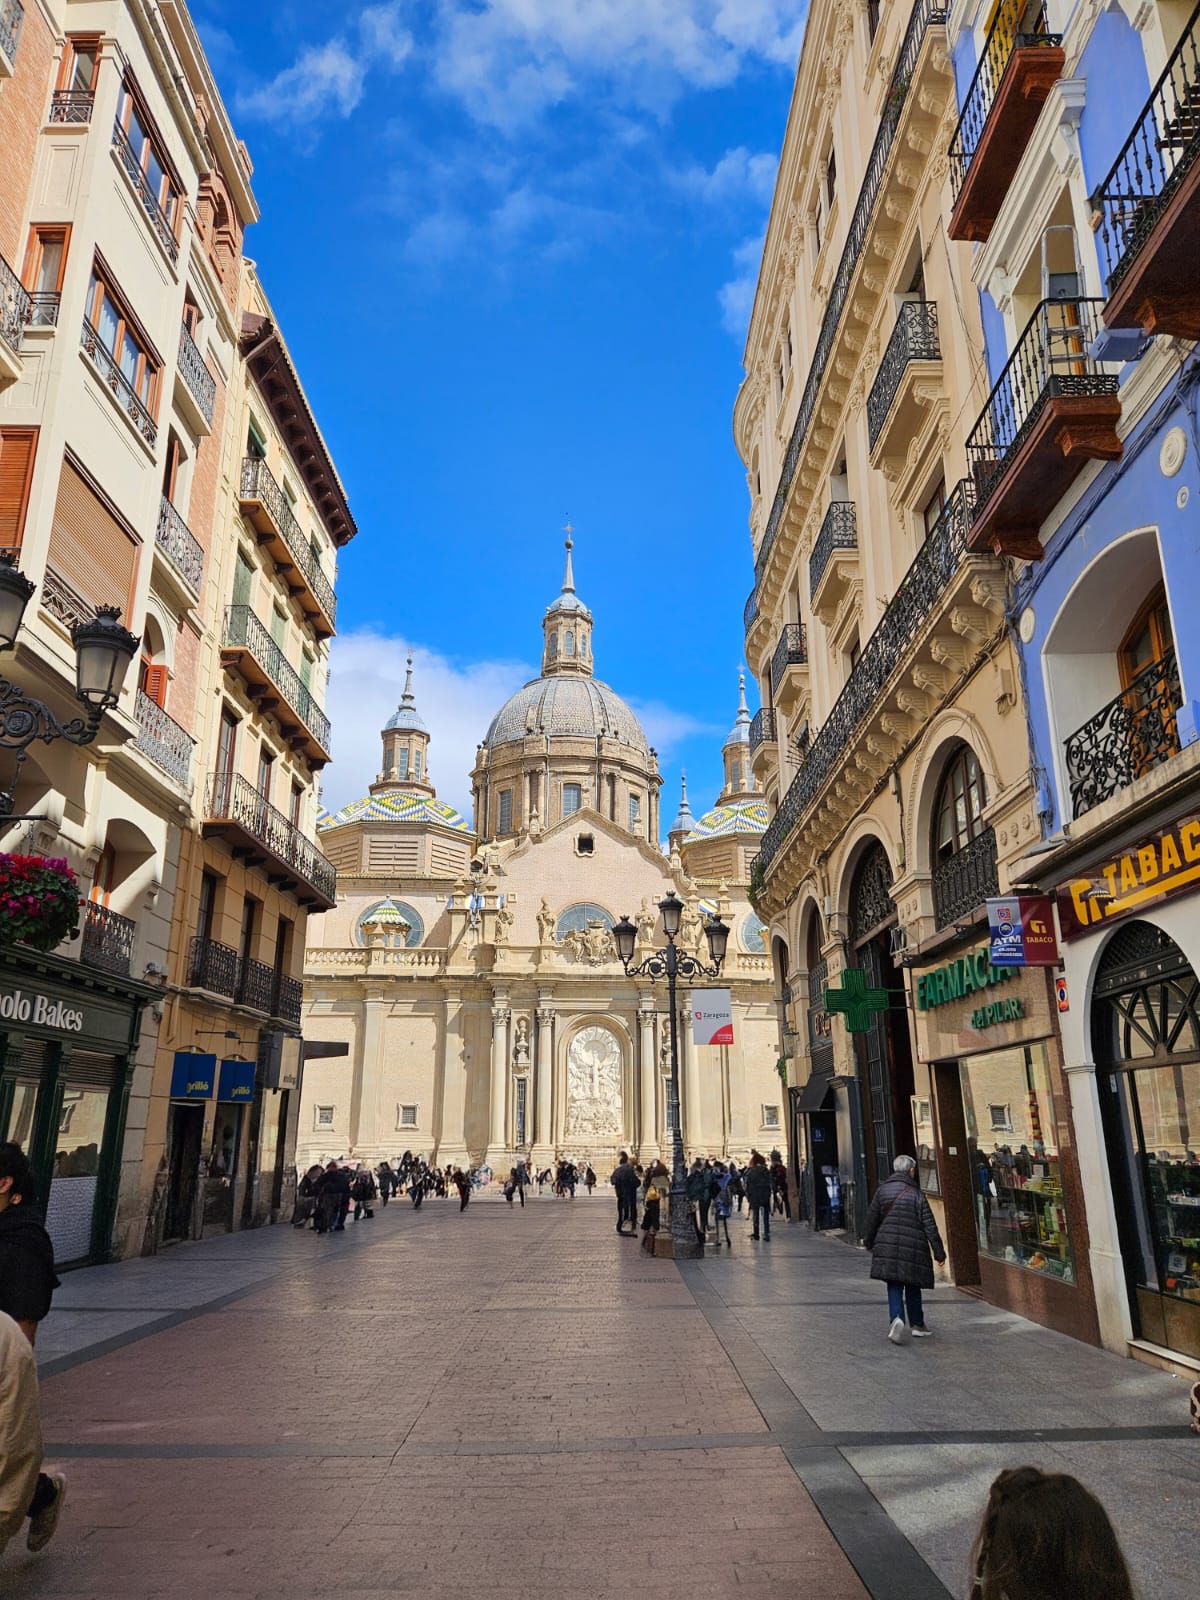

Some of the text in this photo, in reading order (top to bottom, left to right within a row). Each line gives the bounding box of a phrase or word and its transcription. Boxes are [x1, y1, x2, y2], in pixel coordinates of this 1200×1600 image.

[993, 934, 1021, 946] ATM
[0, 990, 83, 1031] olo Bakes
[971, 998, 1023, 1029] del PILAR
